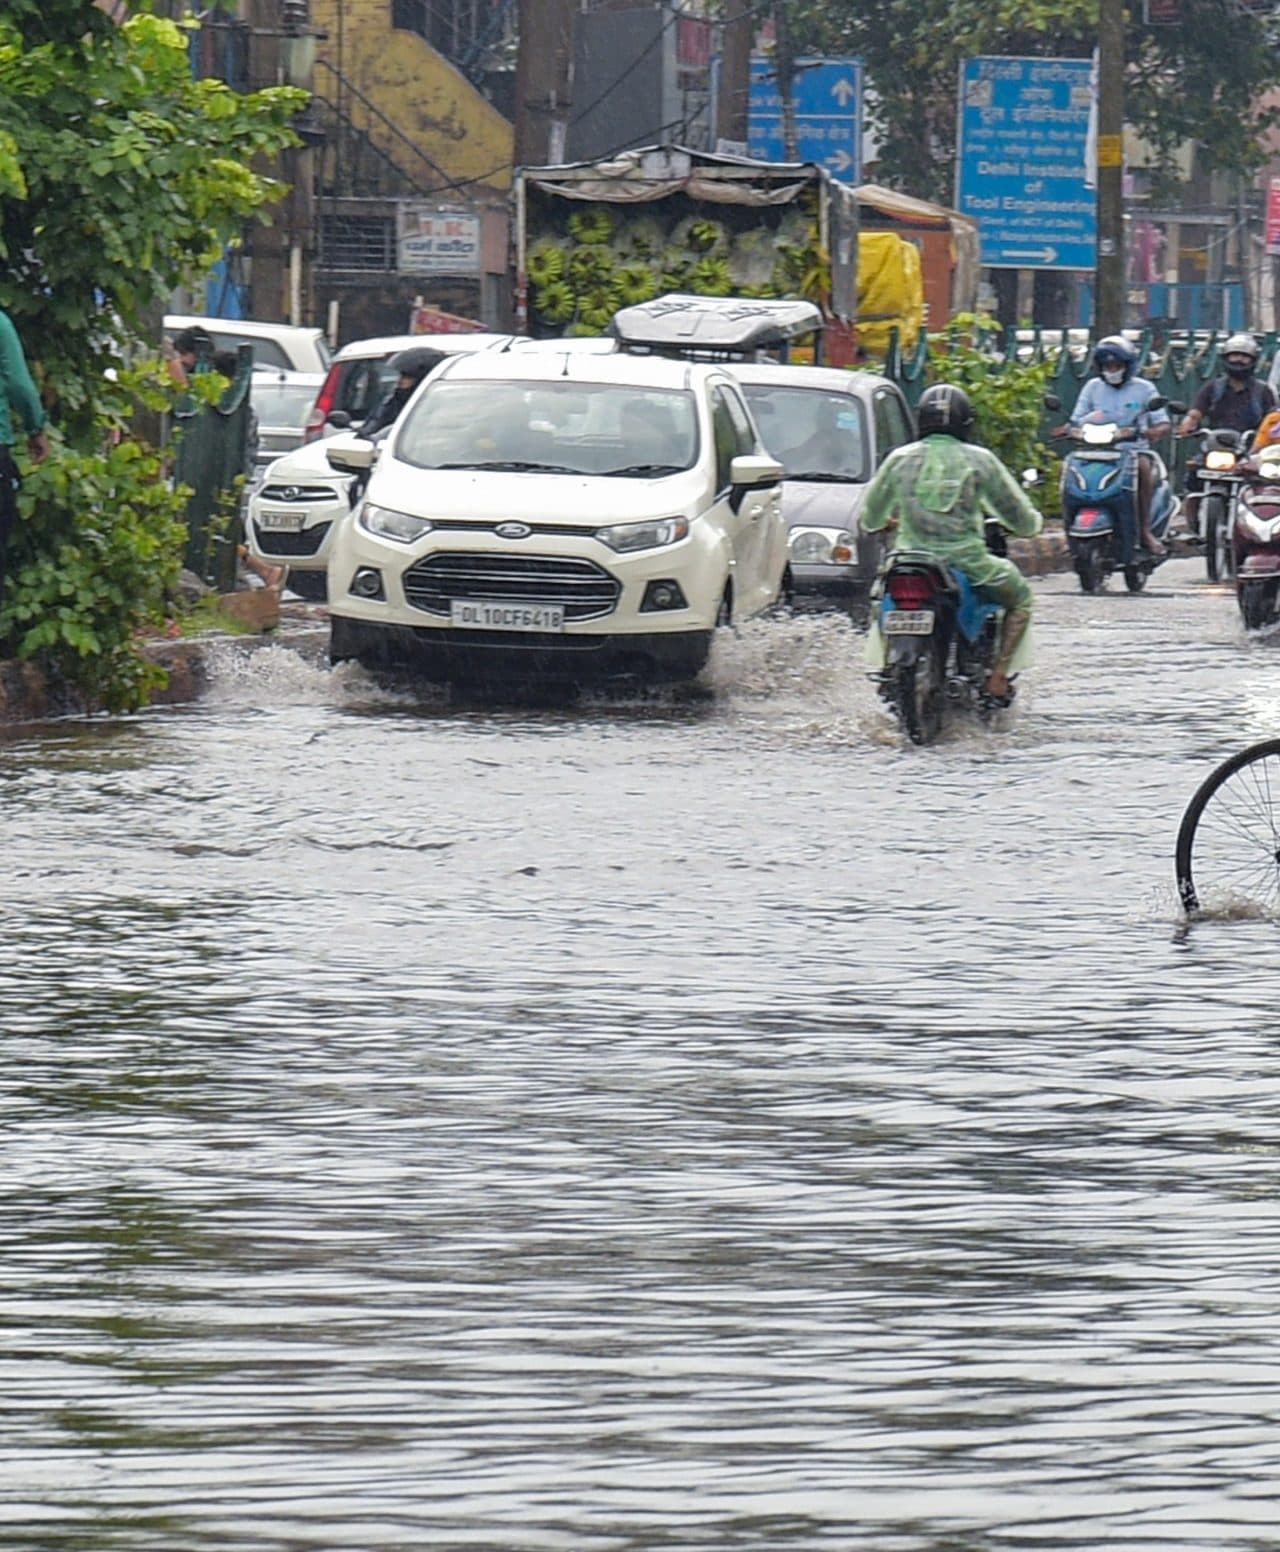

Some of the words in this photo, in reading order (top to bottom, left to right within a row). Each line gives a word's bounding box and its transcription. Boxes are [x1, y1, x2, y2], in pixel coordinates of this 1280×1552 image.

[977, 161, 1019, 175] Delhi
[1023, 180, 1042, 193] of
[963, 195, 999, 209] Tool
